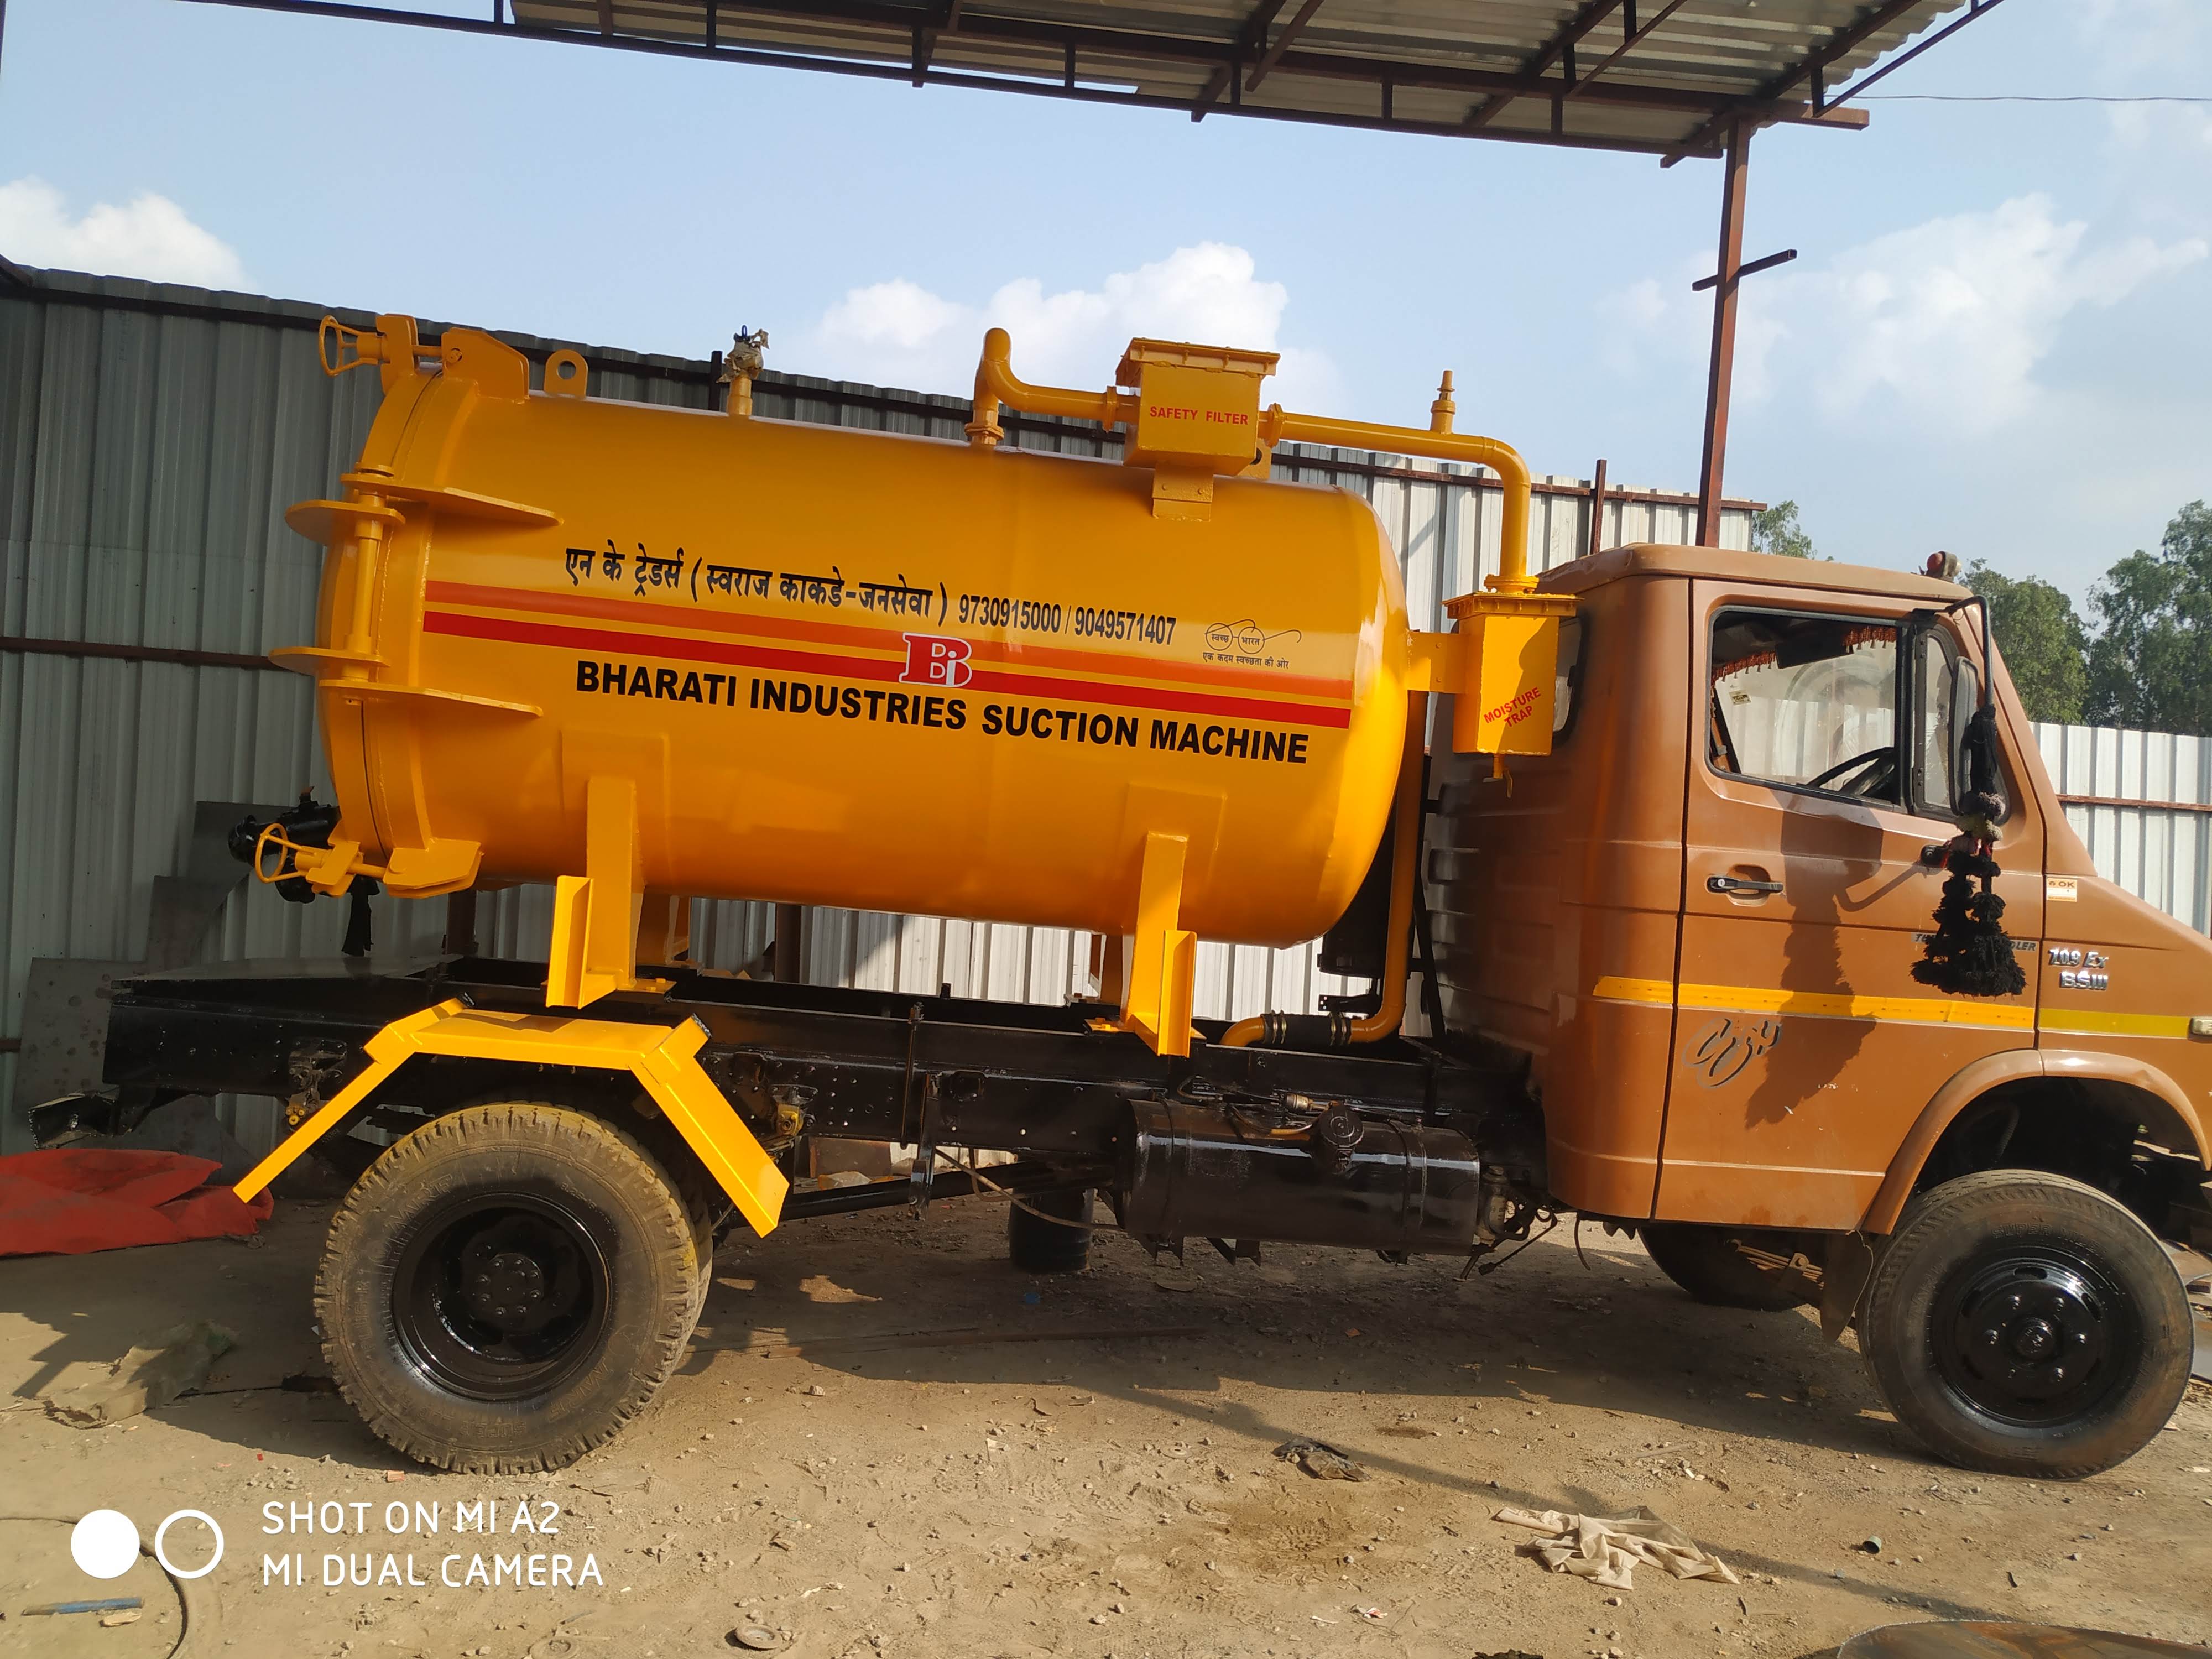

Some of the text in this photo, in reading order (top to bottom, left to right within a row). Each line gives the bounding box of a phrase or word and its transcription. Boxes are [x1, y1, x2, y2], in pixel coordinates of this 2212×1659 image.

[1150, 406, 1248, 425] SAFETY FILTER
[565, 547, 596, 587] एन
[602, 539, 626, 582] के
[634, 542, 684, 597] ट्रेडर्स
[959, 594, 1061, 633] 9730915000
[1074, 606, 1177, 645] 9049571407
[1242, 637, 1260, 645] भारत
[1203, 651, 1214, 662] एक
[1217, 653, 1234, 663] कदम
[1265, 656, 1274, 667] की
[576, 660, 1309, 764] BHARATI INDUSTRIES SUCTION MACHINE
[1483, 687, 1541, 724] MOISTURE
[1504, 705, 1533, 727] TRAP
[2048, 948, 2081, 967] 709
